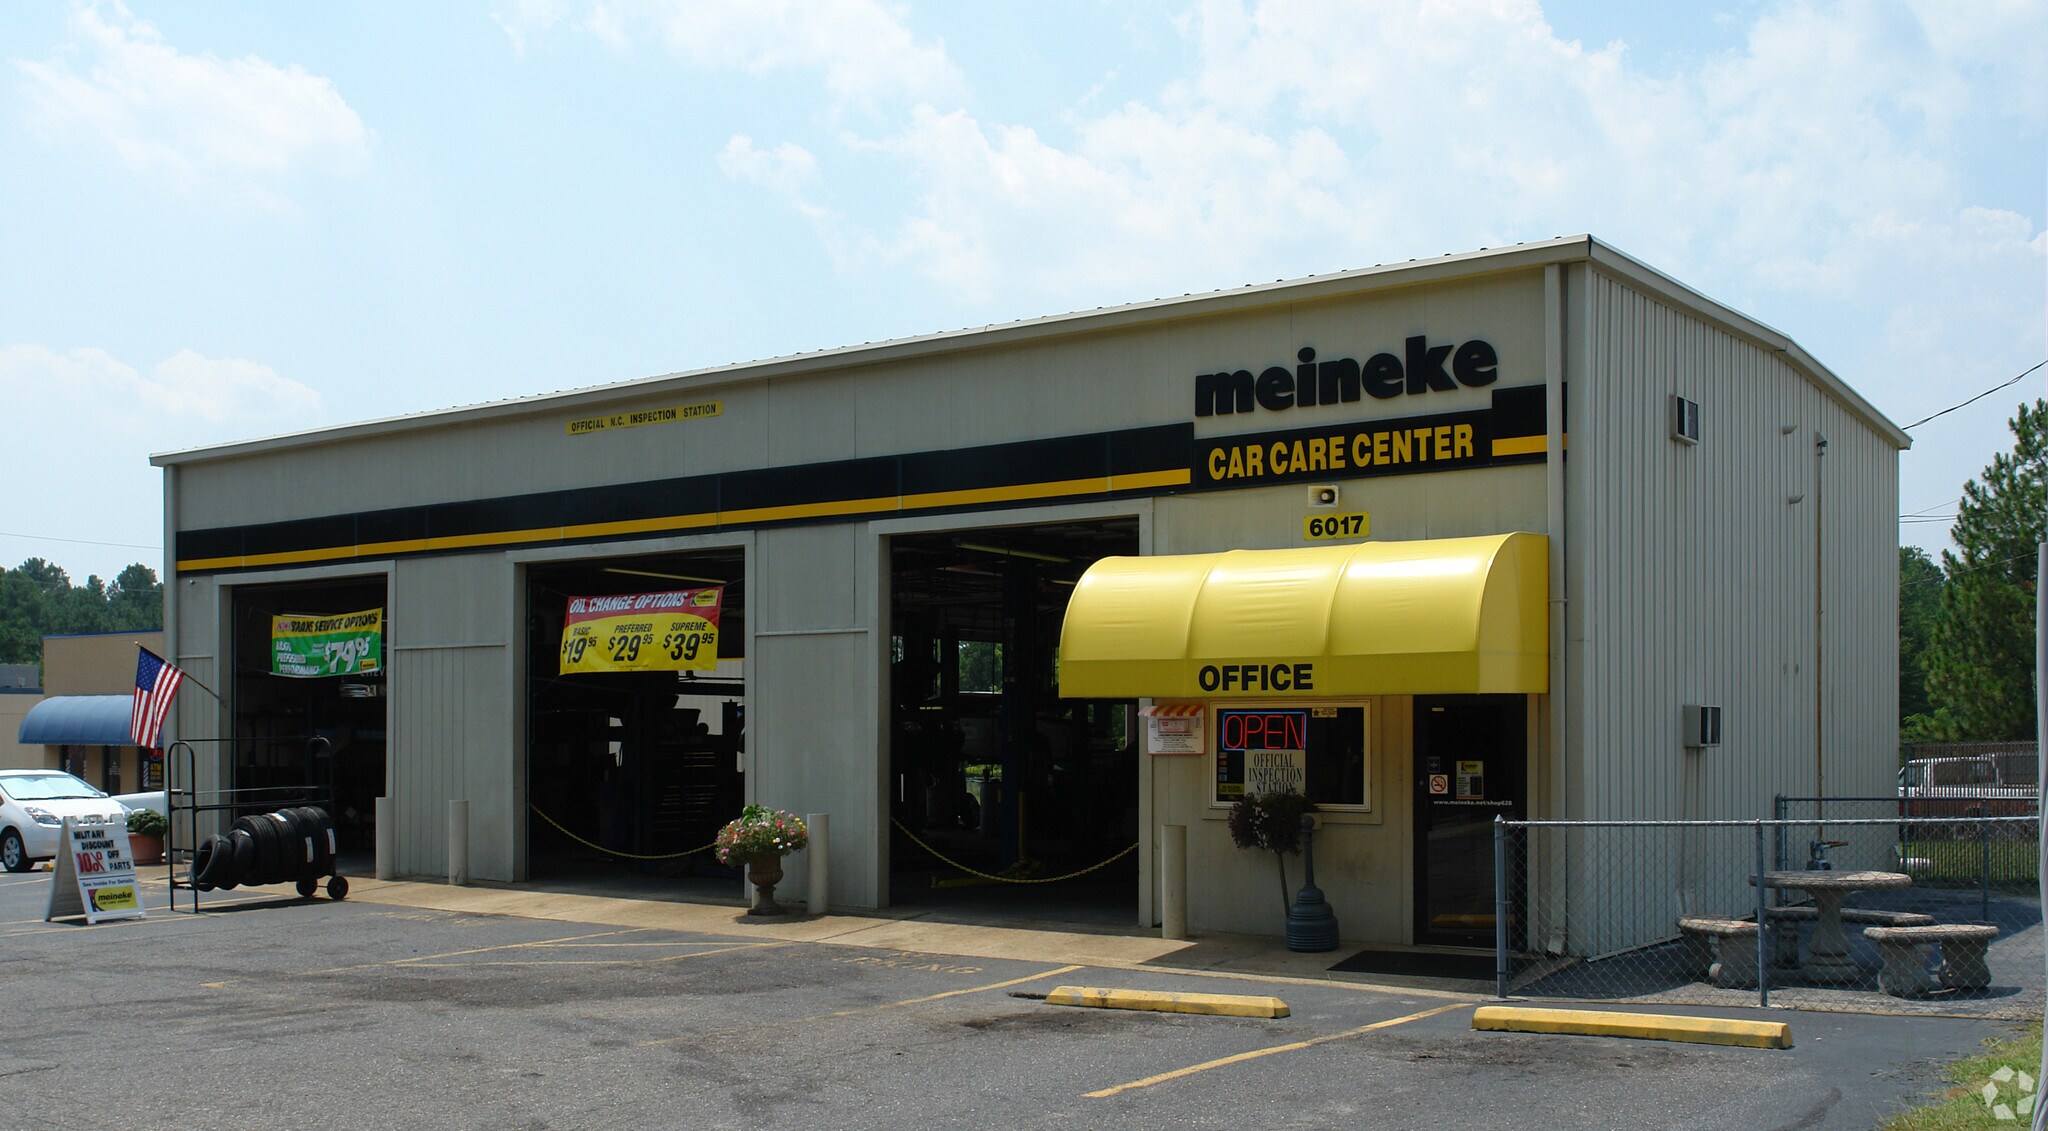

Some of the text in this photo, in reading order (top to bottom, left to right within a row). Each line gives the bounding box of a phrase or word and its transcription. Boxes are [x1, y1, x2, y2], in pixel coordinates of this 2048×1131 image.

[1195, 335, 1498, 417] meineke
[571, 404, 716, 432] OFFICIAL N.C. INSPECTION STATION
[1208, 424, 1474, 481] CAR CARE CENTER
[1308, 515, 1365, 537] 6017
[569, 599, 586, 614] OIL
[588, 595, 632, 612] CHANGE
[634, 592, 689, 610] OPTIONS
[315, 617, 344, 632] SERVICE
[344, 612, 378, 629] OPTIONS
[572, 622, 708, 636] BASIC PREFERRED SUPREME
[1198, 663, 1314, 692] OFFICE
[1225, 715, 1305, 749] OPEN
[1253, 753, 1295, 768] OFFICIAL
[1248, 767, 1303, 783] INSPECTION
[81, 840, 114, 850] DISCOUNT
[107, 850, 119, 859] OFF
[109, 861, 131, 871] PARTS
[98, 891, 132, 901] meineke
